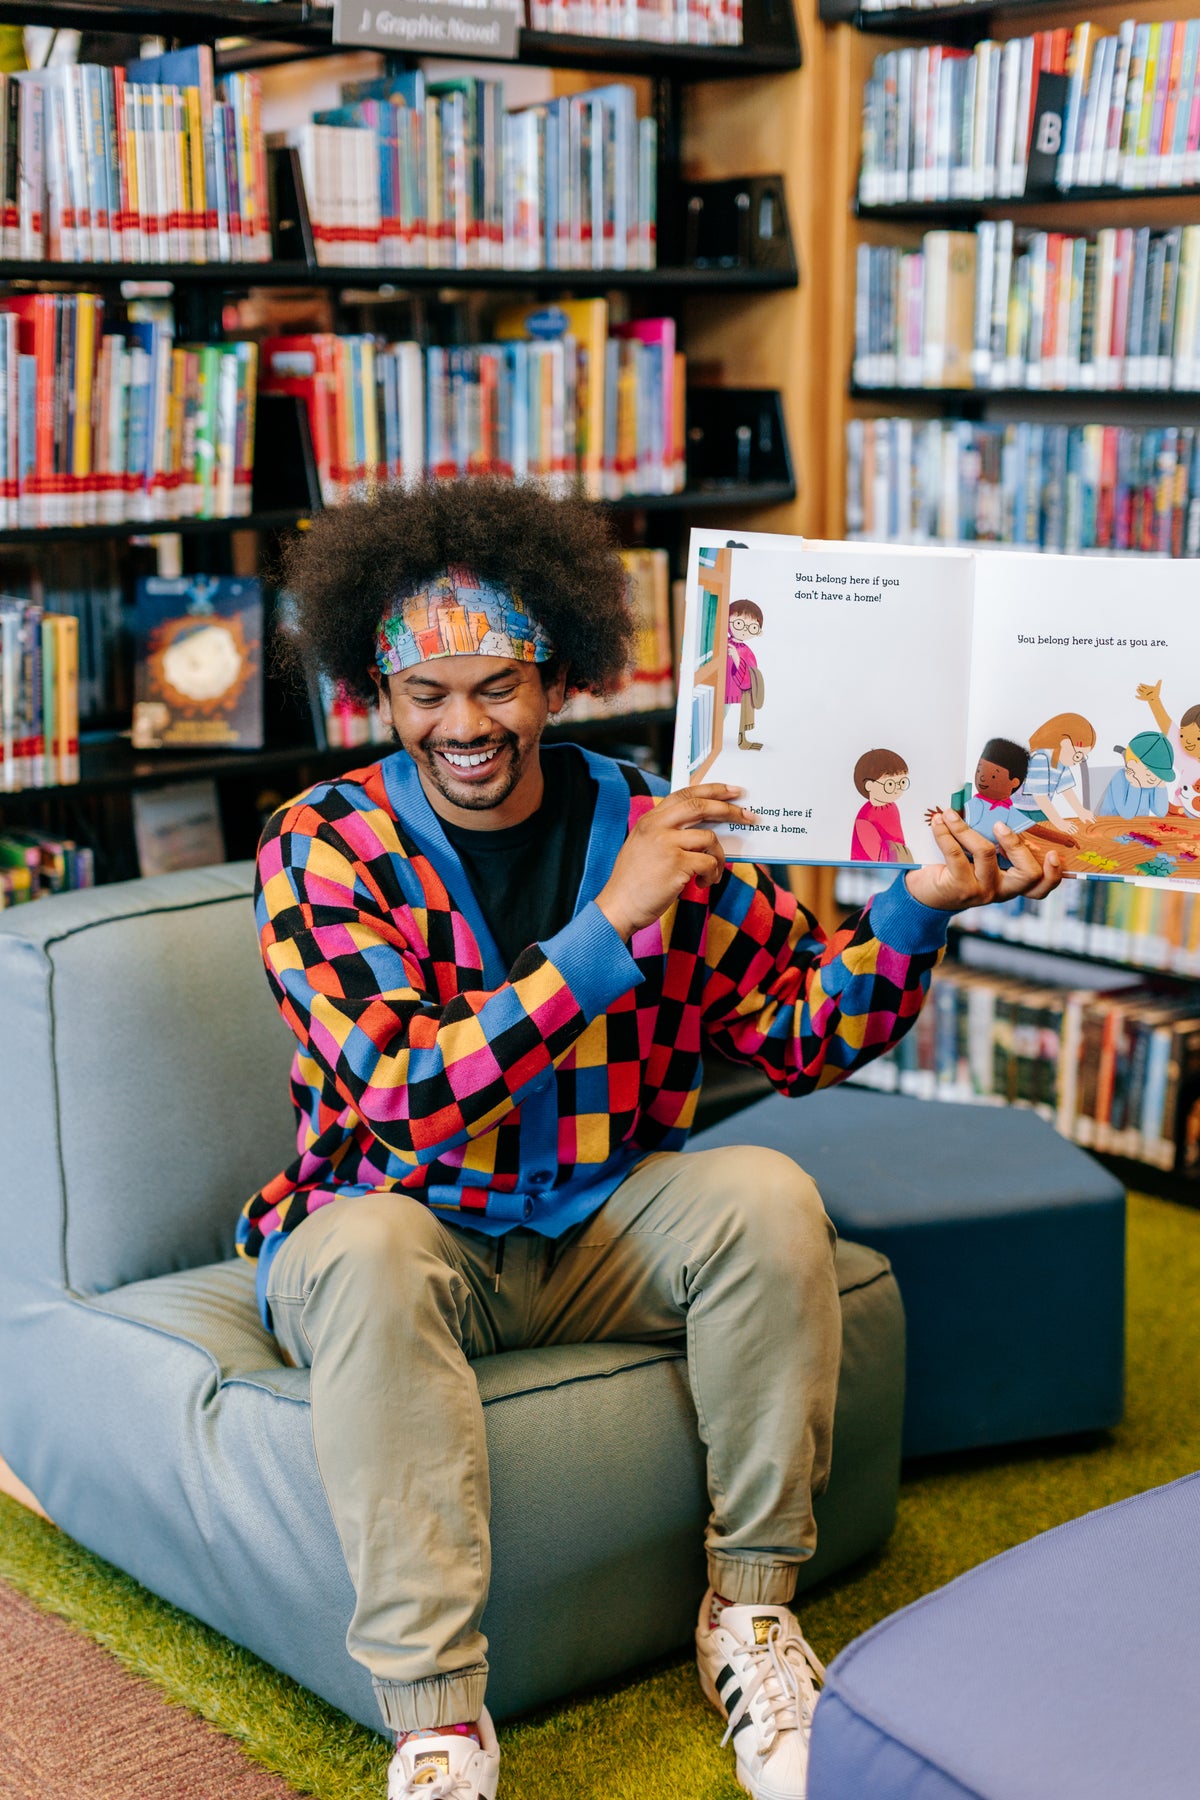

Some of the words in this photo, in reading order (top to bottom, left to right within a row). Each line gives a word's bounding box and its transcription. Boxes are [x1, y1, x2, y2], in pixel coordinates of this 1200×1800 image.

[359, 8, 371, 33] J
[376, 10, 446, 41] Graphic
[448, 16, 500, 44] Novel
[1035, 110, 1063, 155] B
[795, 572, 813, 583] You
[816, 574, 847, 585] belong
[850, 575, 870, 585] here
[872, 575, 880, 586] if
[882, 578, 900, 588] you
[794, 590, 818, 600] don't
[821, 591, 843, 601] have
[845, 594, 851, 602] a
[854, 592, 882, 603] home!
[1017, 634, 1035, 644] You
[1037, 635, 1070, 646] belong
[1072, 635, 1093, 646] here
[1094, 636, 1114, 648] just
[1116, 638, 1127, 646] as
[1129, 638, 1148, 648] you
[1150, 639, 1168, 647] are.
[782, 807, 803, 817] here
[805, 808, 813, 818] if
[729, 823, 746, 831] you
[748, 823, 771, 831] have
[772, 825, 779, 833] a
[781, 823, 808, 834] home.
